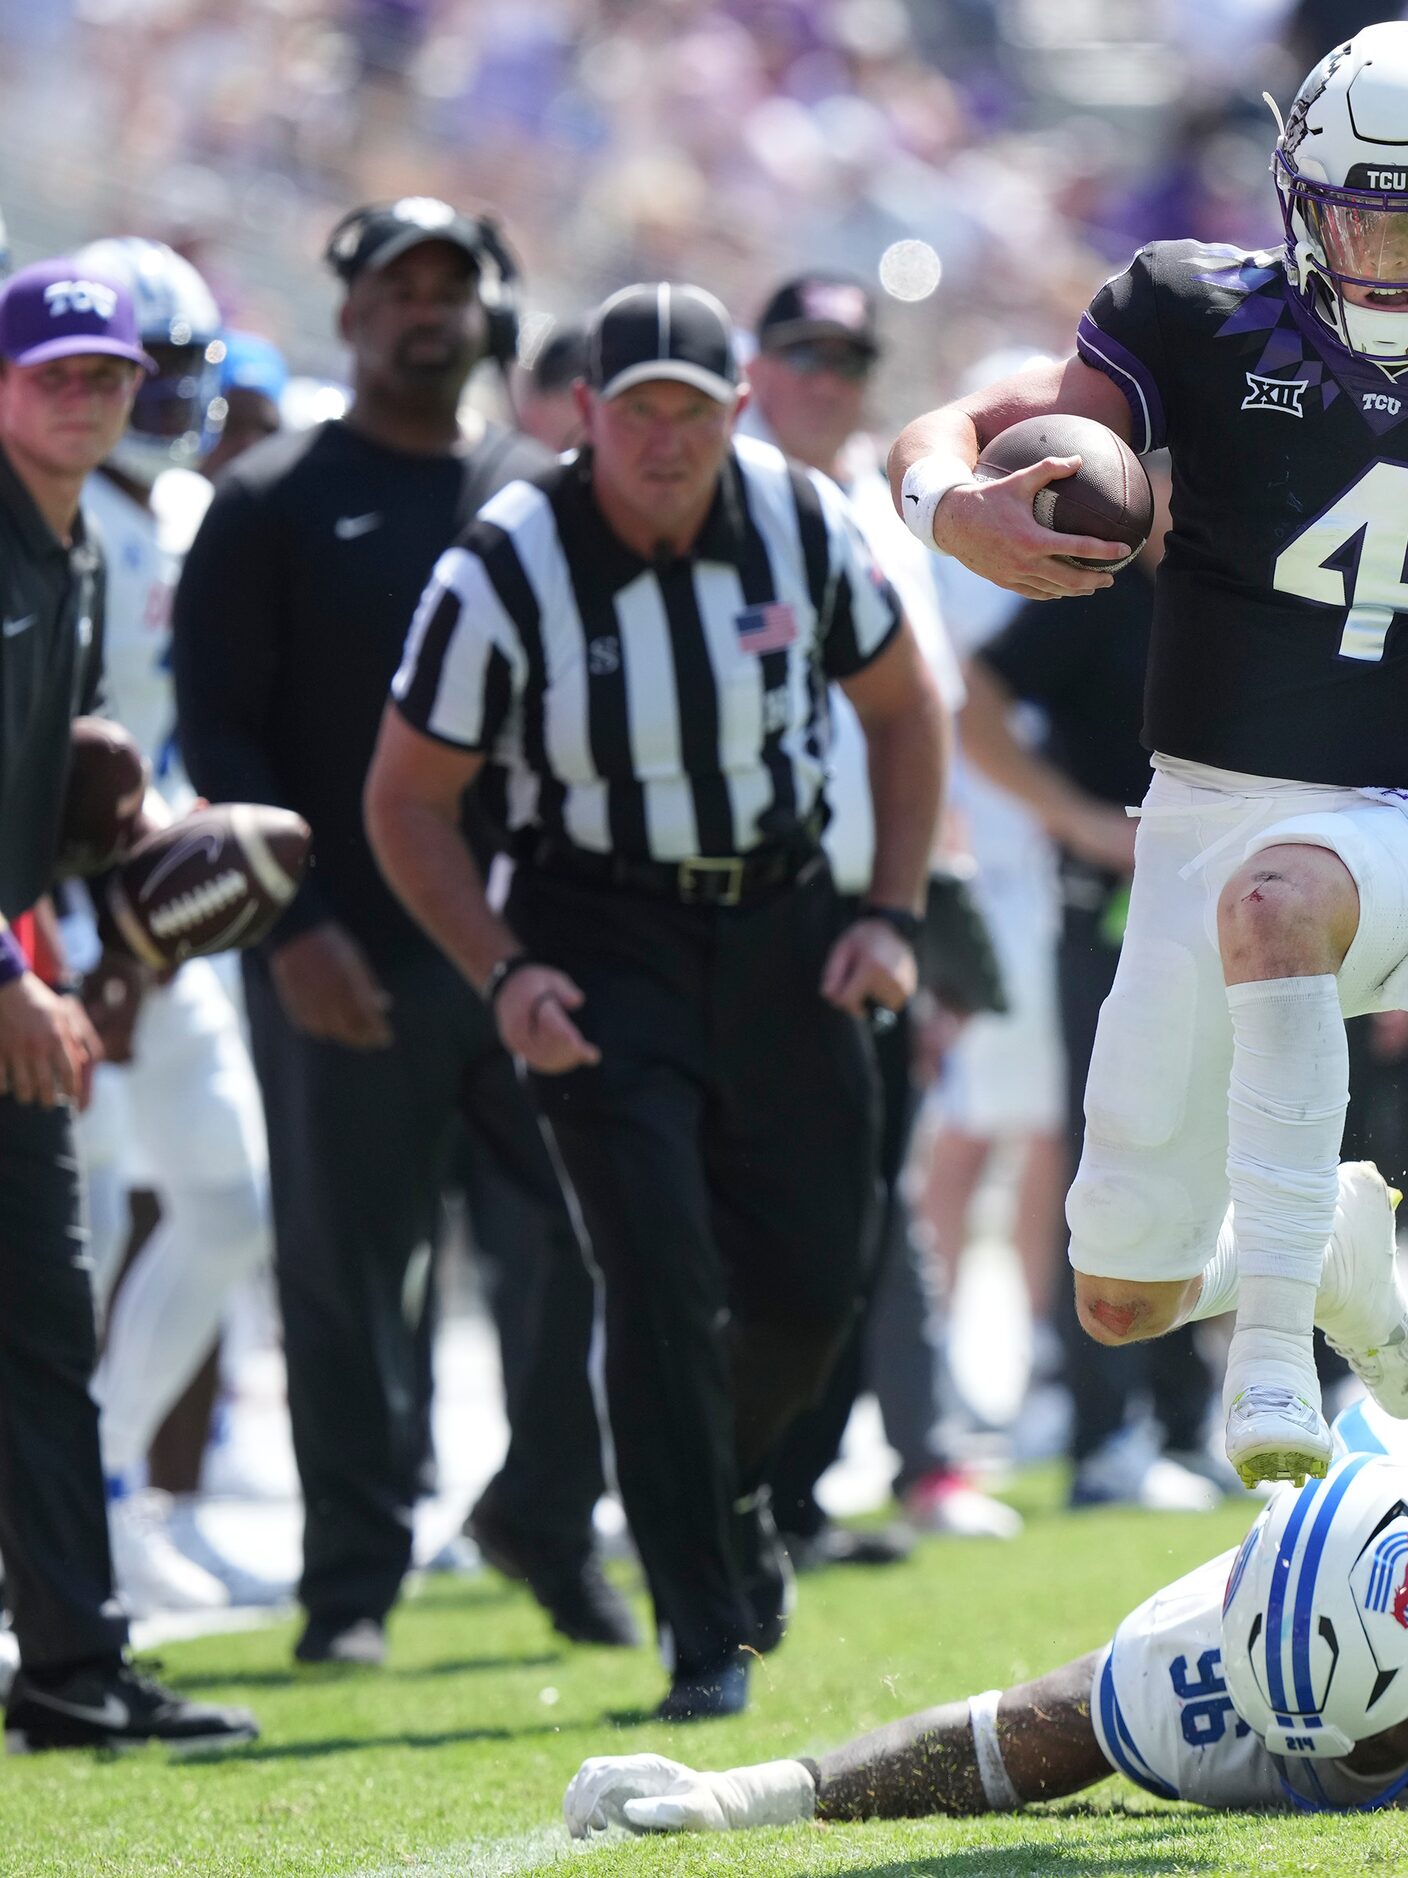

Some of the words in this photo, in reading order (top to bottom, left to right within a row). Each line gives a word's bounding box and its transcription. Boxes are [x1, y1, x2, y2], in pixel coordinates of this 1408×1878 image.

[1367, 170, 1407, 191] TCU
[44, 280, 118, 319] TCU
[1362, 393, 1401, 416] TCU
[589, 635, 620, 675] S
[1285, 1735, 1317, 1751] 214
